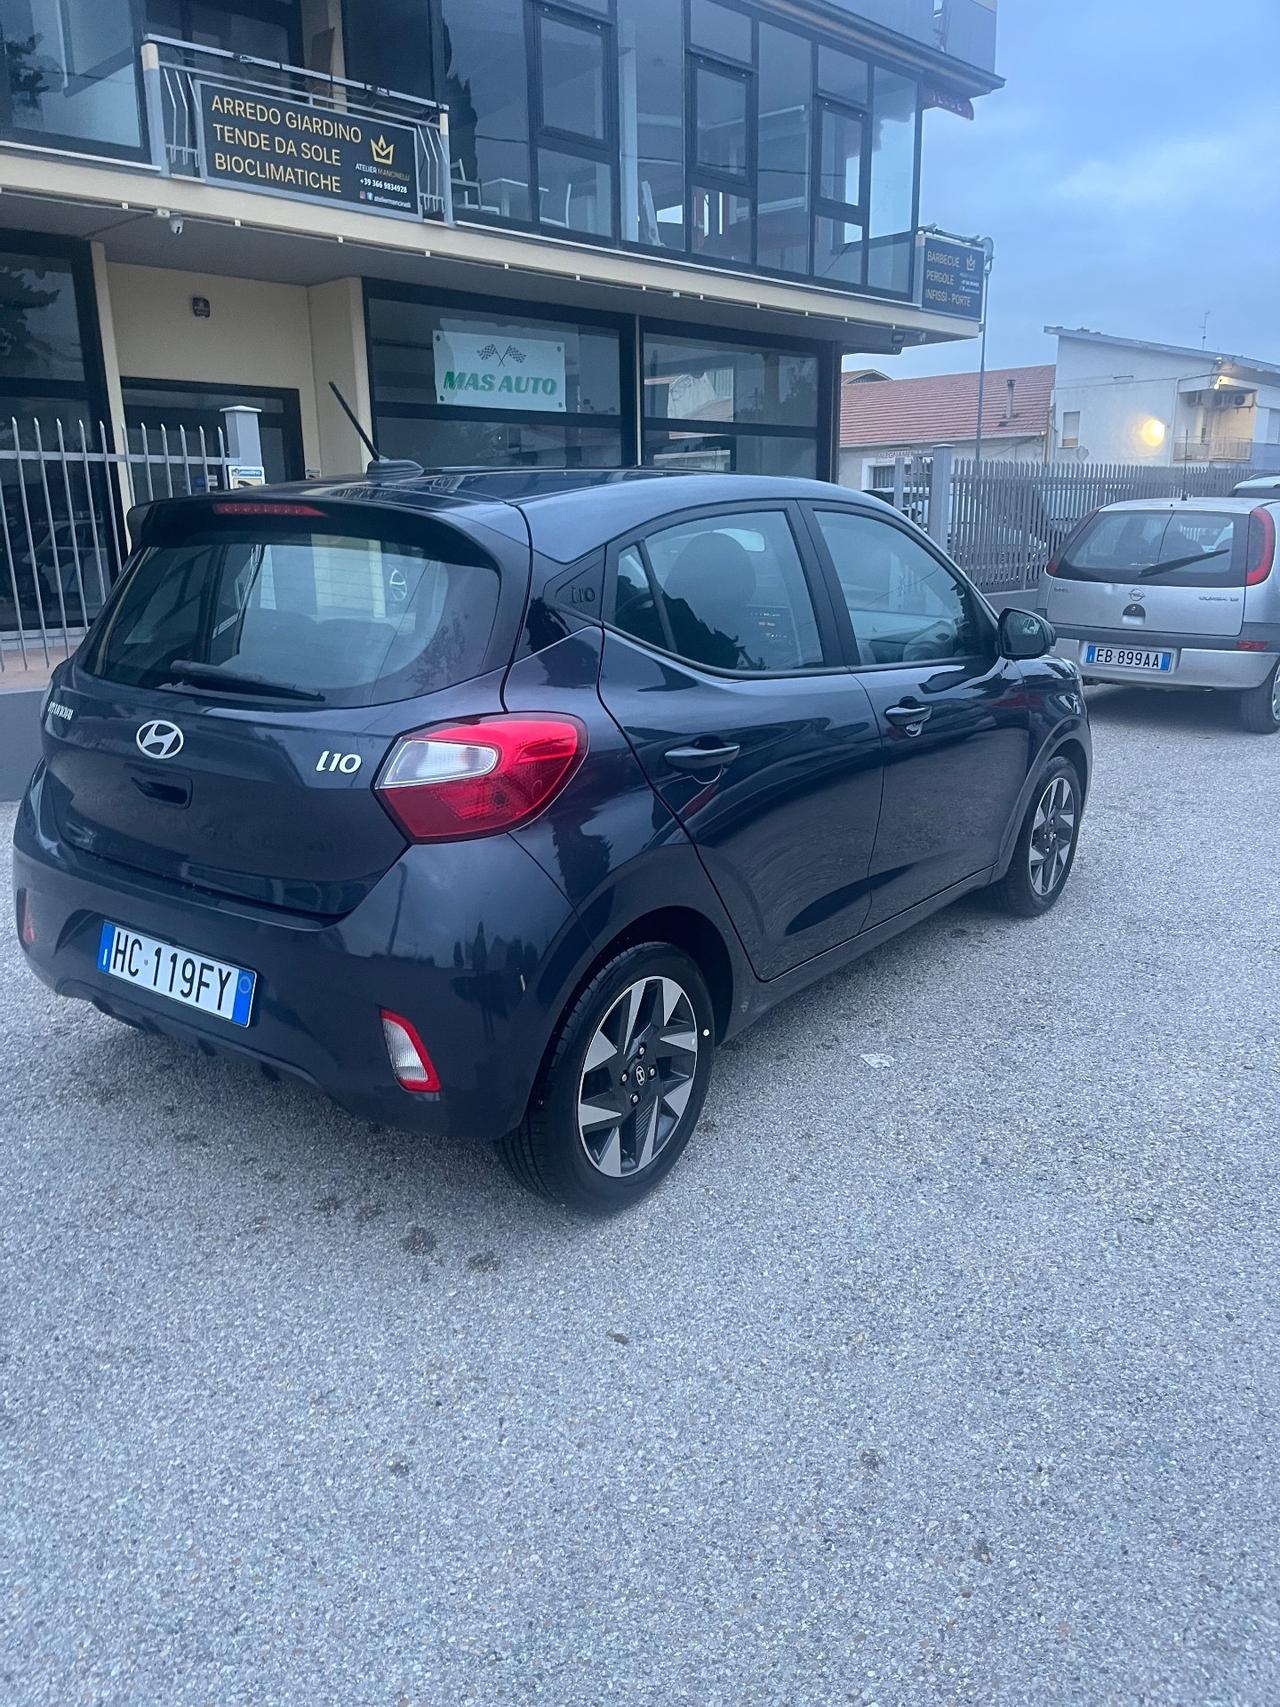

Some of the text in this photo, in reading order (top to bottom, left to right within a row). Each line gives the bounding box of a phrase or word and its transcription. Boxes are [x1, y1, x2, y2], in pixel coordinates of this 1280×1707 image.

[211, 95, 362, 144] ARREDO GIARDINO
[212, 123, 342, 166] TENDE DA SOLE
[214, 152, 342, 193] BIOCLIMATICHE
[355, 162, 378, 174] ATELIER
[359, 176, 408, 194] +39 366 9834928
[927, 250, 960, 267] BARBECUE
[926, 269, 955, 286] PERGOLE
[951, 292, 972, 307] PORTE
[443, 370, 558, 396] MAS AUTO
[1096, 648, 1160, 668] EB 899AA
[112, 931, 143, 977] HC
[152, 946, 232, 1011] 119FY
